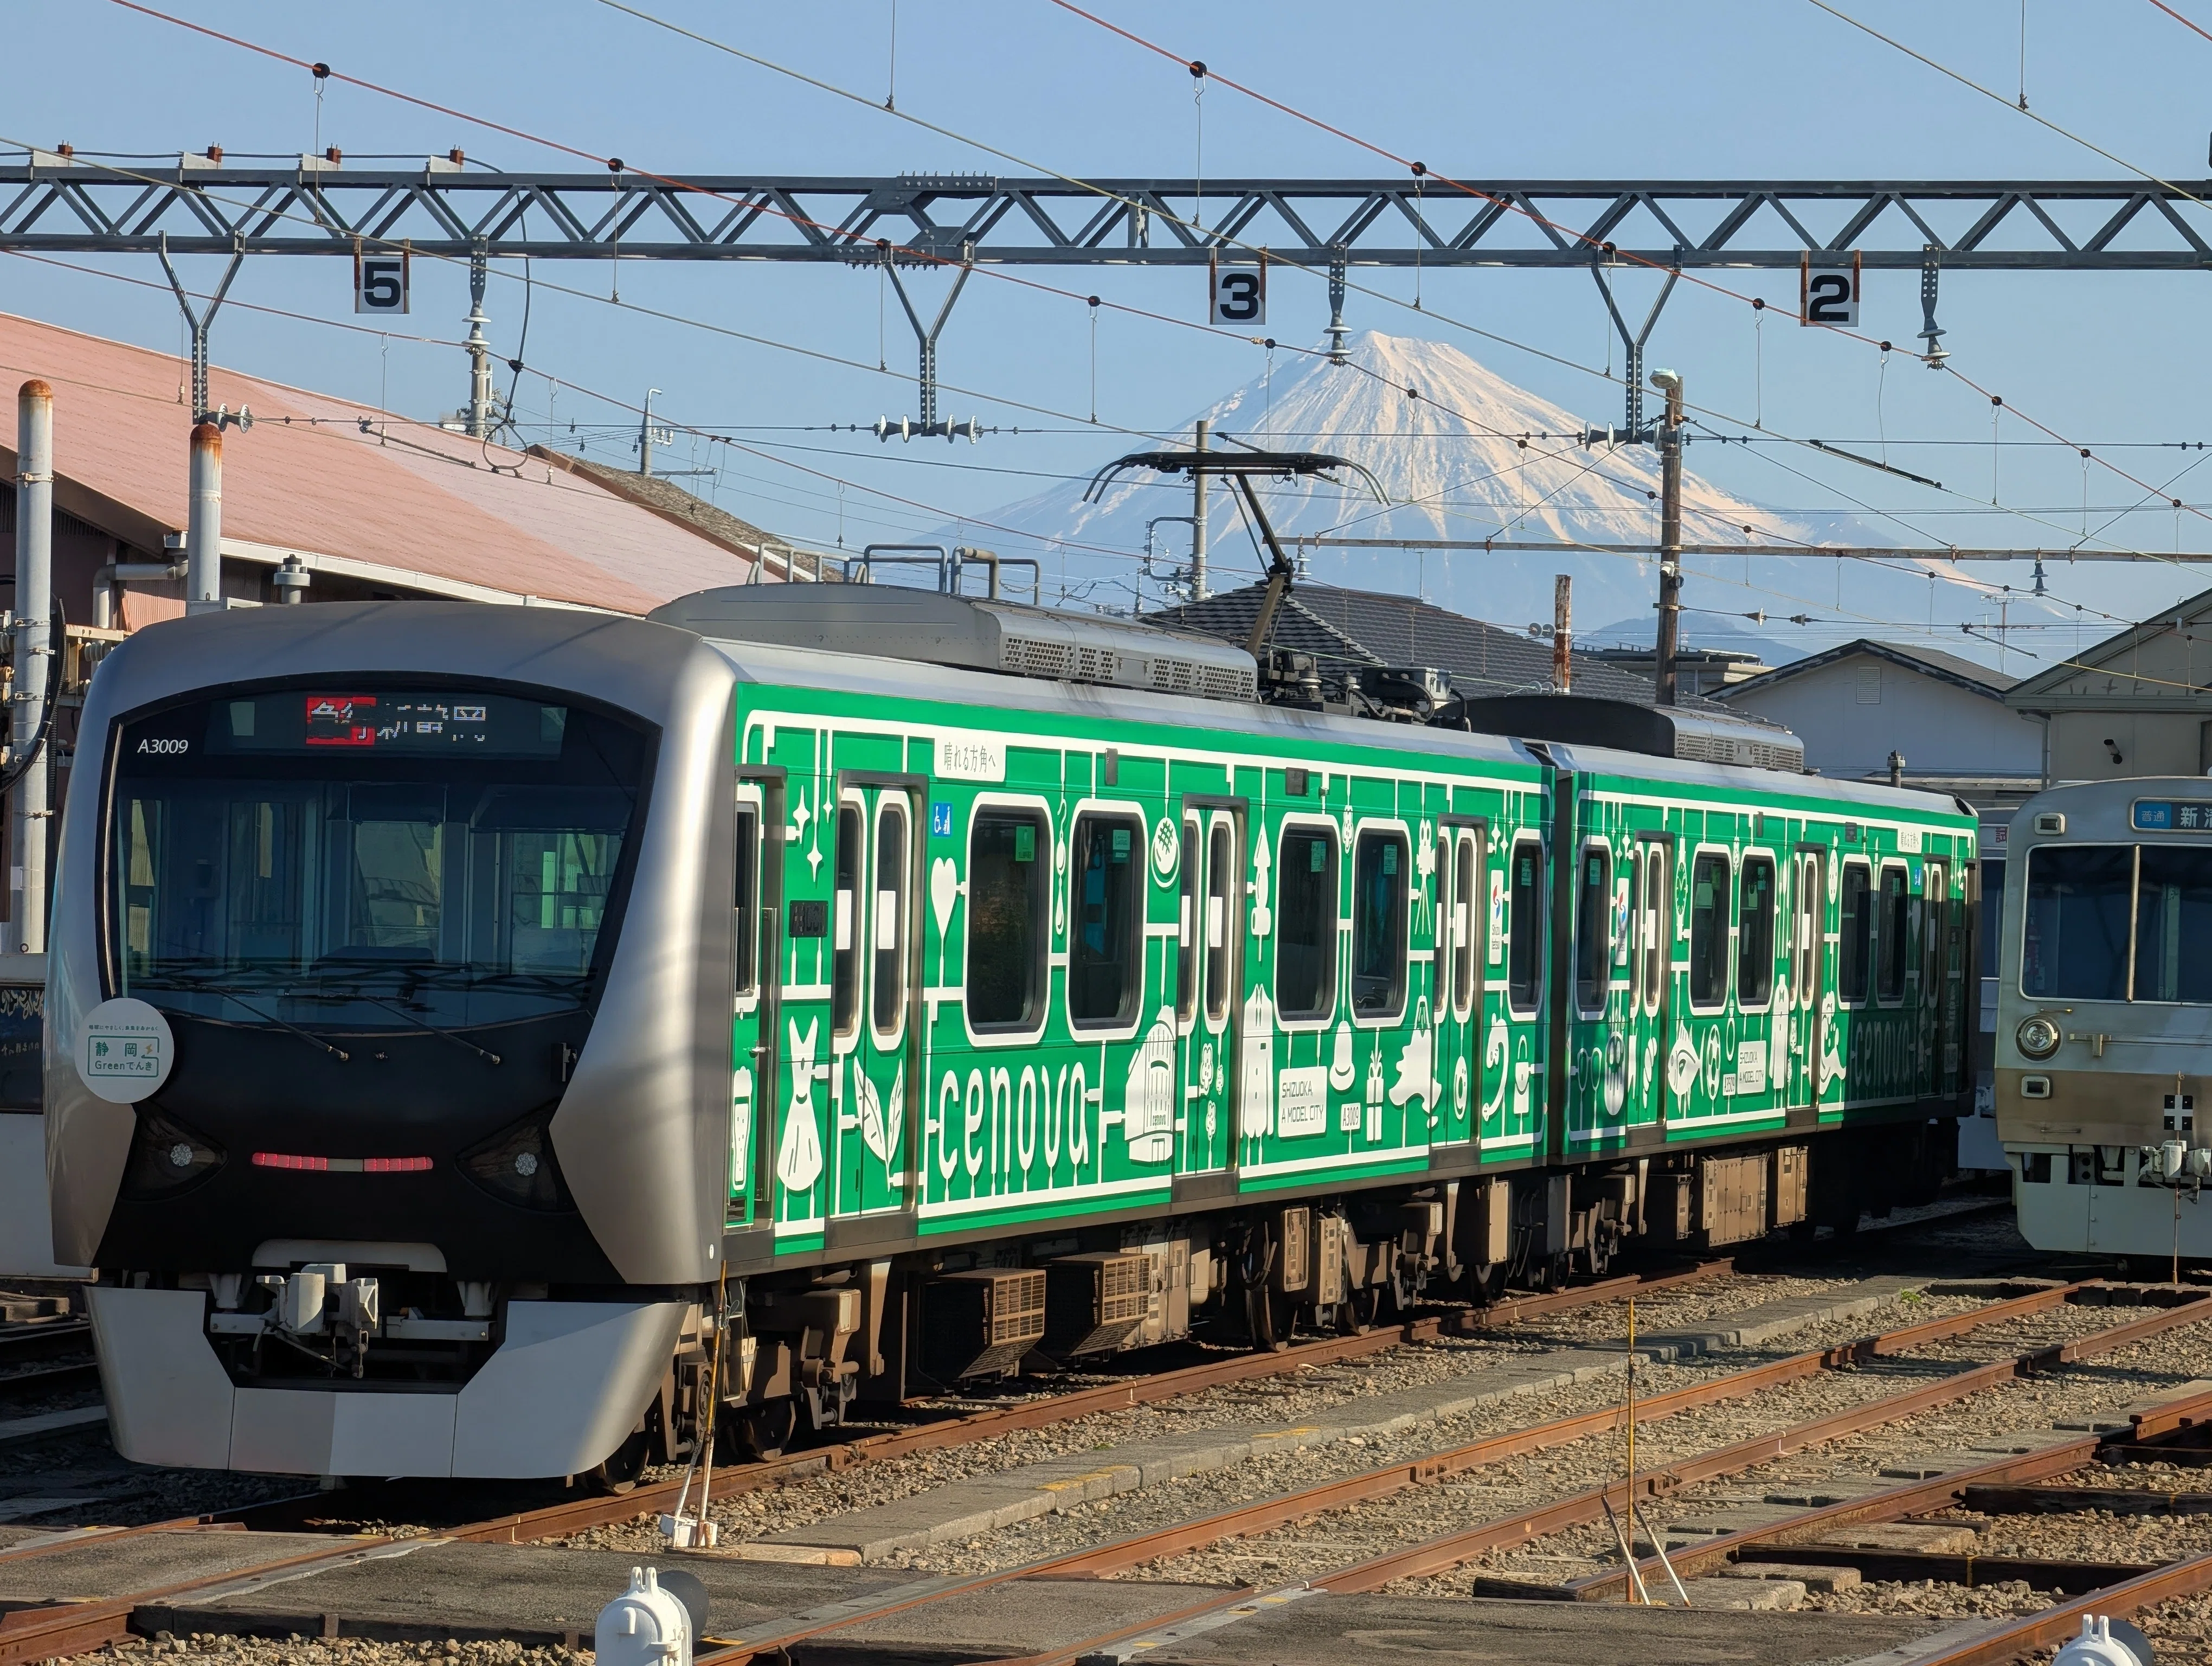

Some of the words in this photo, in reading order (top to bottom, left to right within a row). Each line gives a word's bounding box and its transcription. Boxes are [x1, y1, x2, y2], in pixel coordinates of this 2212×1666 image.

[364, 261, 400, 307] 5
[1220, 273, 1258, 319] 3
[1809, 274, 1849, 322] 2
[137, 739, 189, 754] A3009
[944, 741, 996, 773] 晴れる方角へ
[2141, 810, 2165, 822] 普通
[95, 1041, 137, 1057] 静岡
[1855, 1020, 1910, 1087] cenova
[95, 1060, 152, 1071] Greenでんき
[938, 1061, 1088, 1180] cenova
[1281, 1108, 1286, 1124] A
[1287, 1106, 1308, 1123] MODEL
[1309, 1104, 1324, 1121] CITY
[1342, 1106, 1359, 1127] A3009
